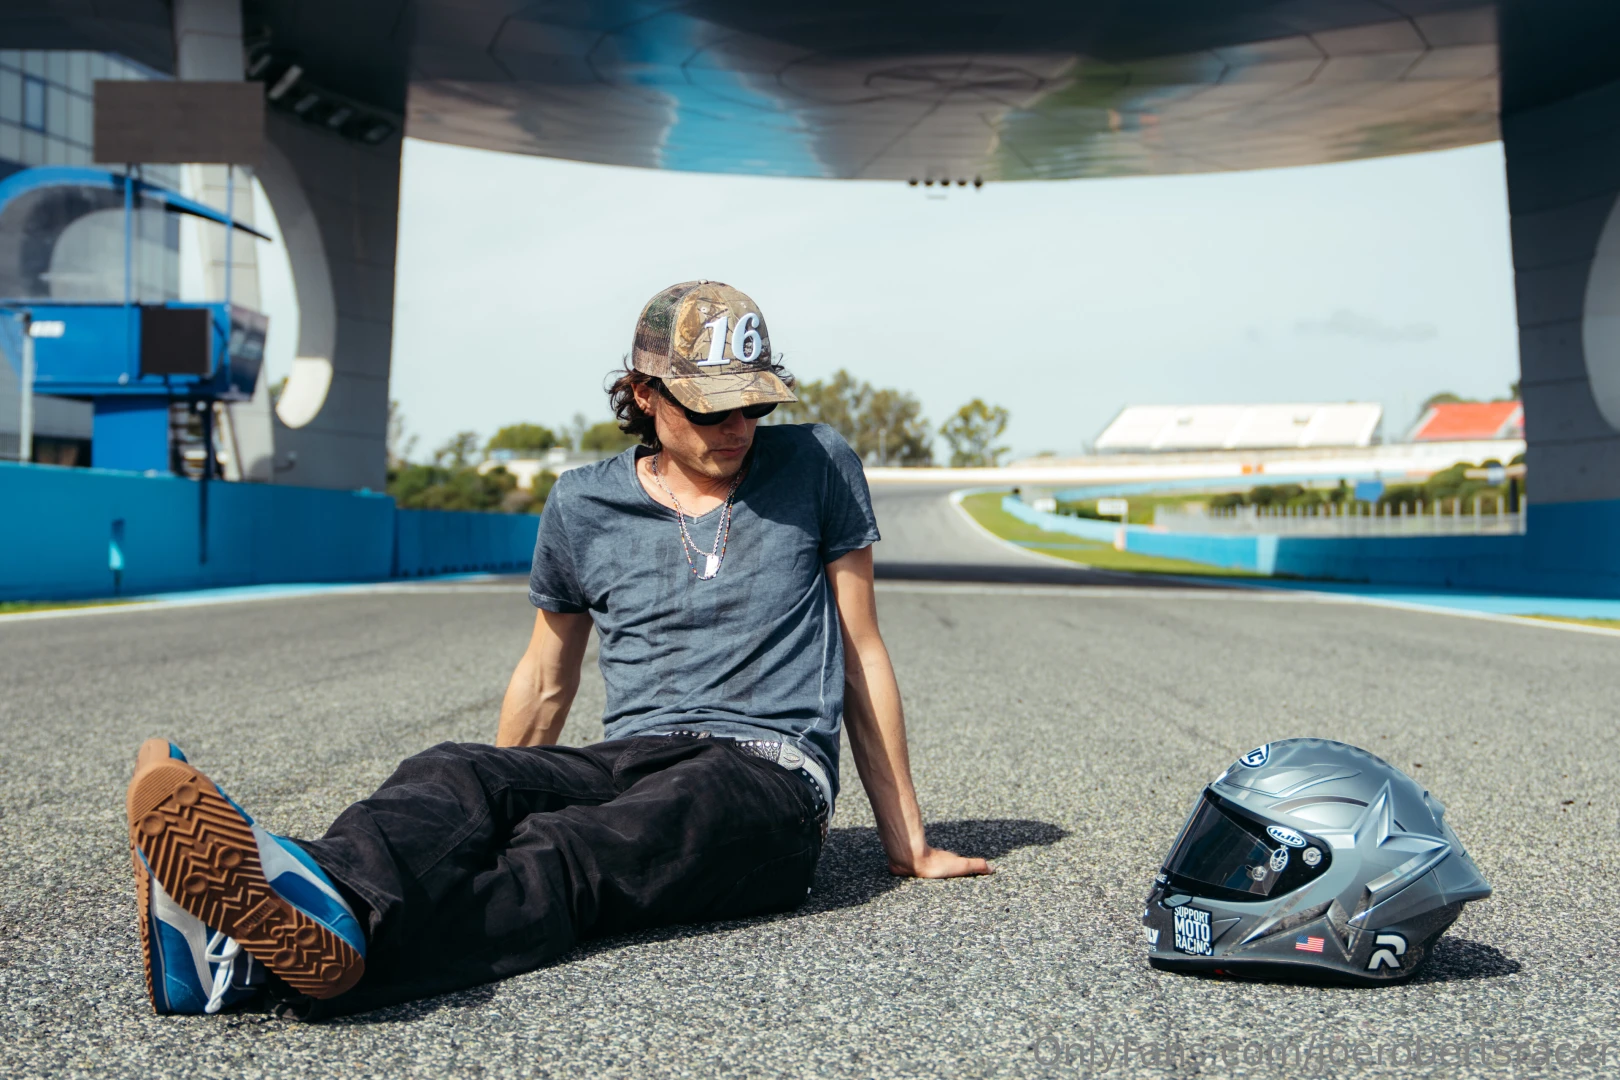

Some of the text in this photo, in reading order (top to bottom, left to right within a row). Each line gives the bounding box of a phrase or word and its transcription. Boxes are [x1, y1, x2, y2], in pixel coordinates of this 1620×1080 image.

[697, 312, 762, 367] 16
[1271, 829, 1301, 844] HJC
[1174, 906, 1210, 924] SUPPORT
[1174, 916, 1210, 942] MOTO
[1175, 934, 1212, 956] RACING
